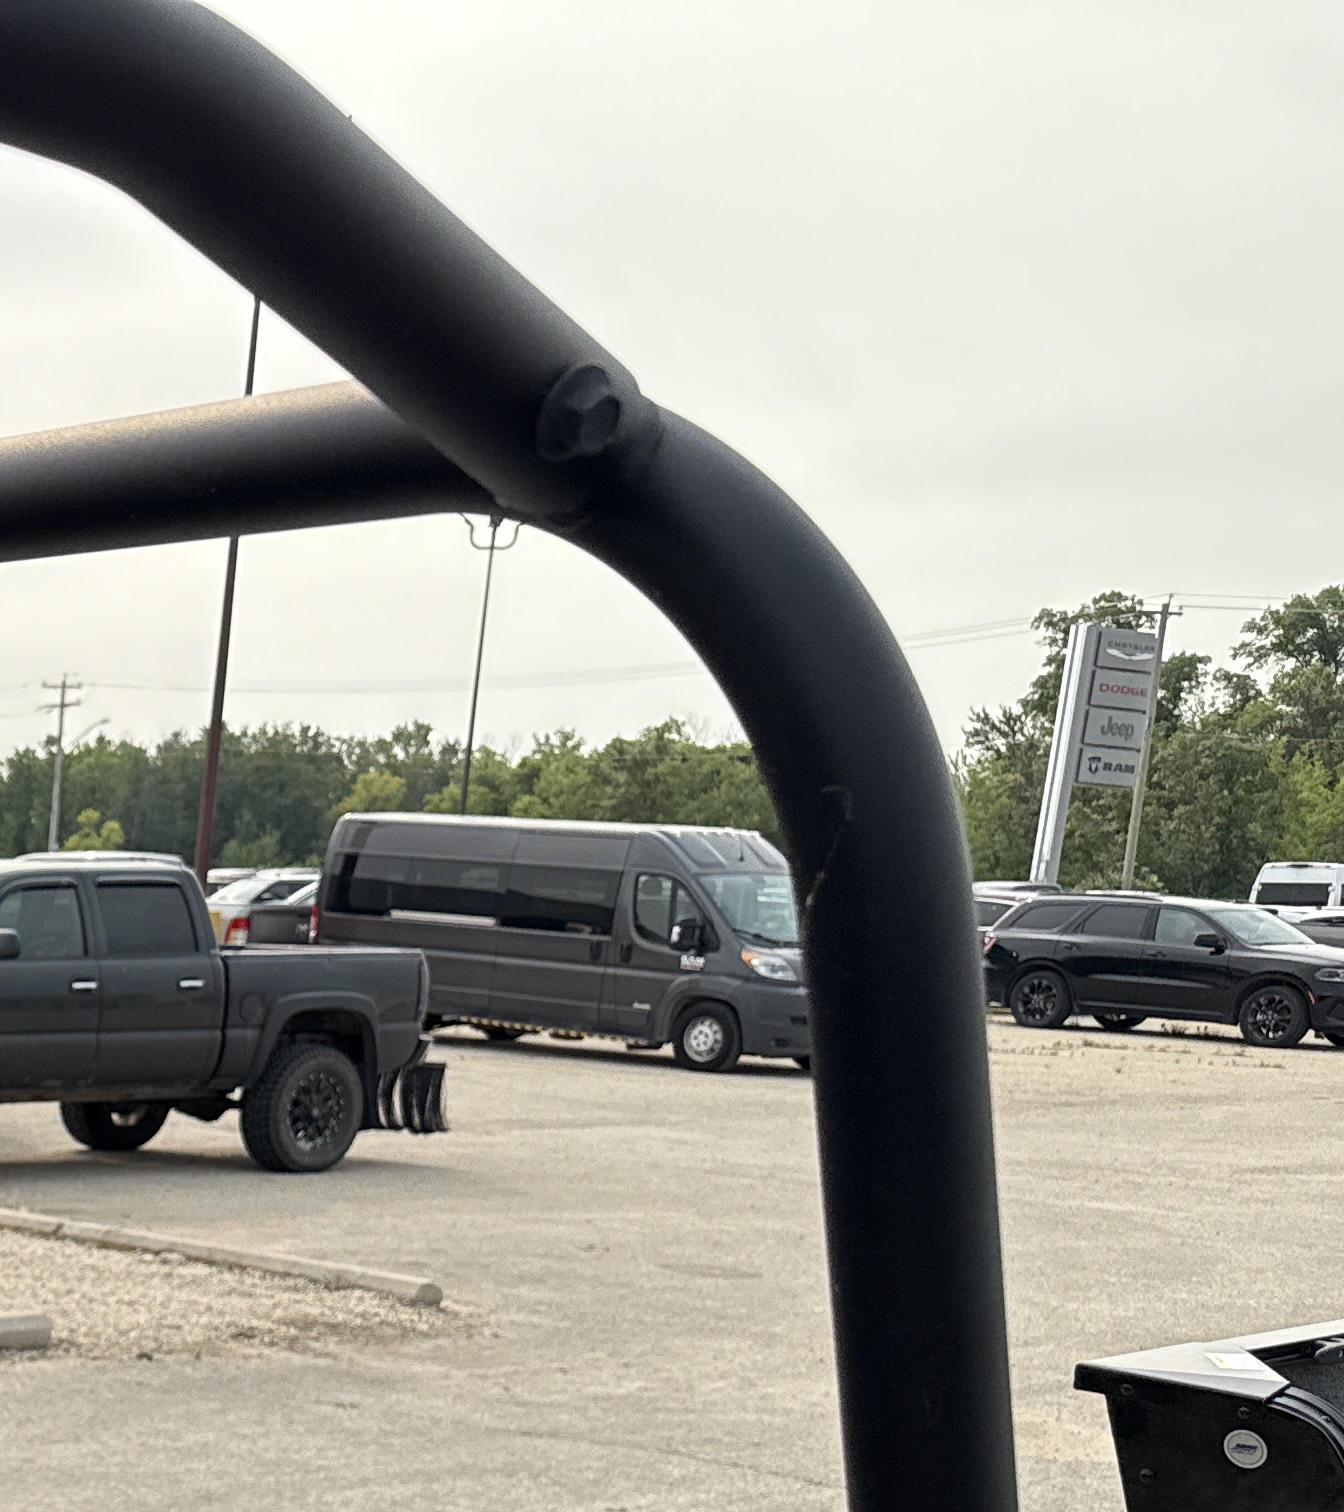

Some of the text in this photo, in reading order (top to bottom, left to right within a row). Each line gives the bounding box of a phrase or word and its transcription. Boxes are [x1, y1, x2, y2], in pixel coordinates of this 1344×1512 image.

[1099, 683, 1147, 697] DODGE
[1100, 716, 1135, 741] Jeep
[1102, 763, 1135, 774] RAM
